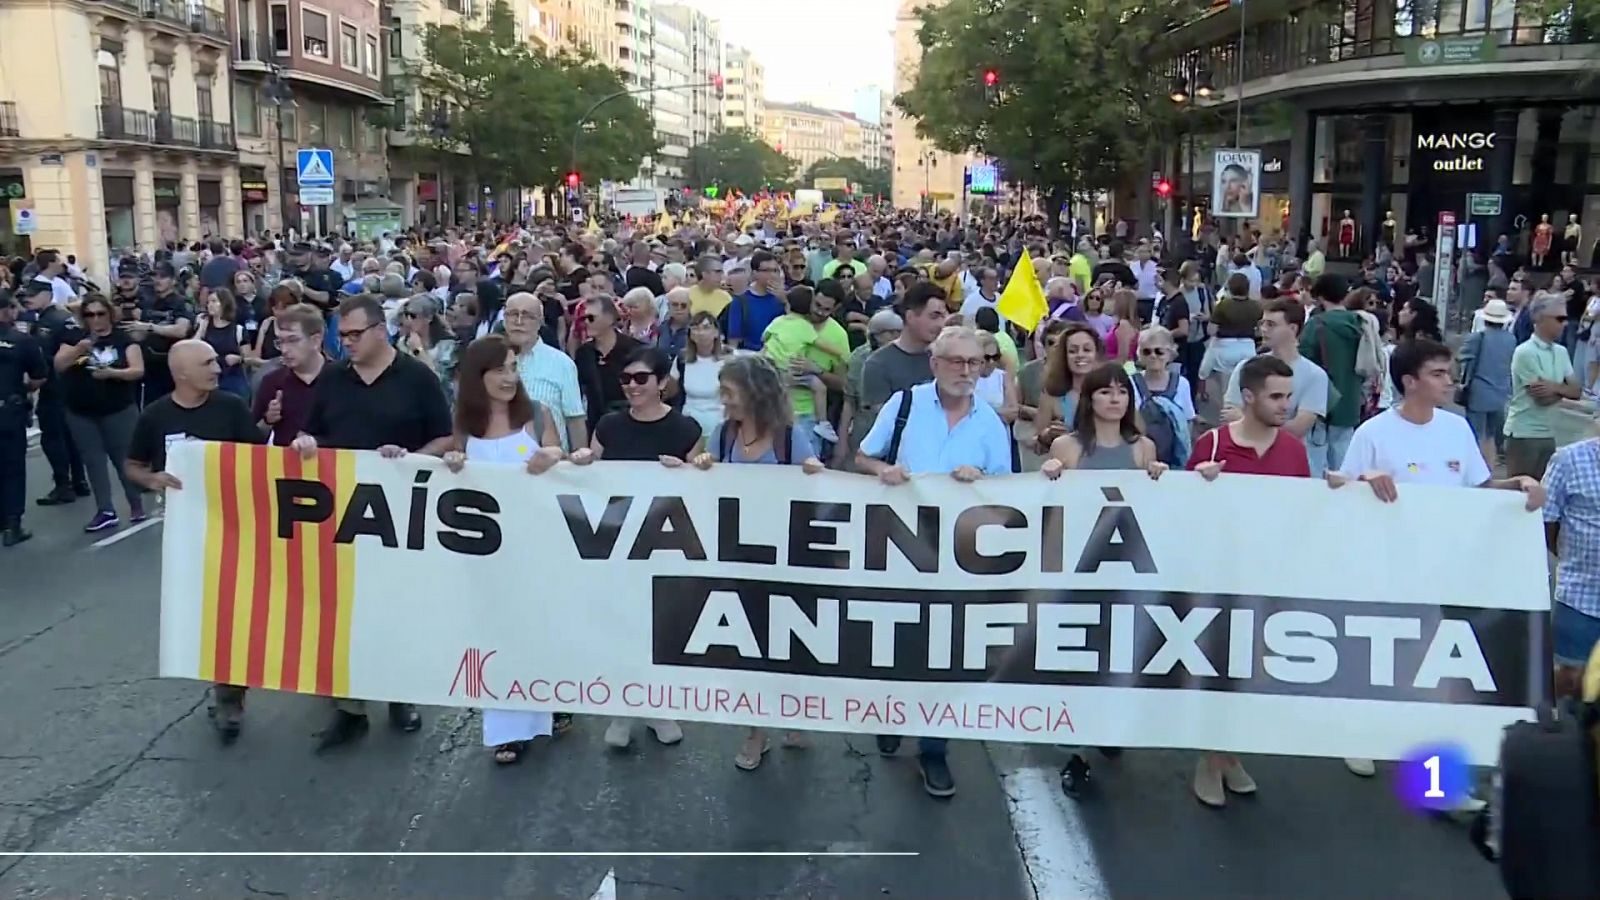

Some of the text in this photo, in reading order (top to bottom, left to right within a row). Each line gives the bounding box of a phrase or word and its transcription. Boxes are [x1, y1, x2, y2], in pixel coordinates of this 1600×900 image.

[1433, 155, 1483, 170] outlet
[275, 469, 1159, 576] PAÍS VALENCIÀ
[683, 589, 1498, 693] ANTIFEIXISTA
[506, 676, 1075, 733] ACCIÓ CULTURAL DEL PAÍS VALENCIÀ
